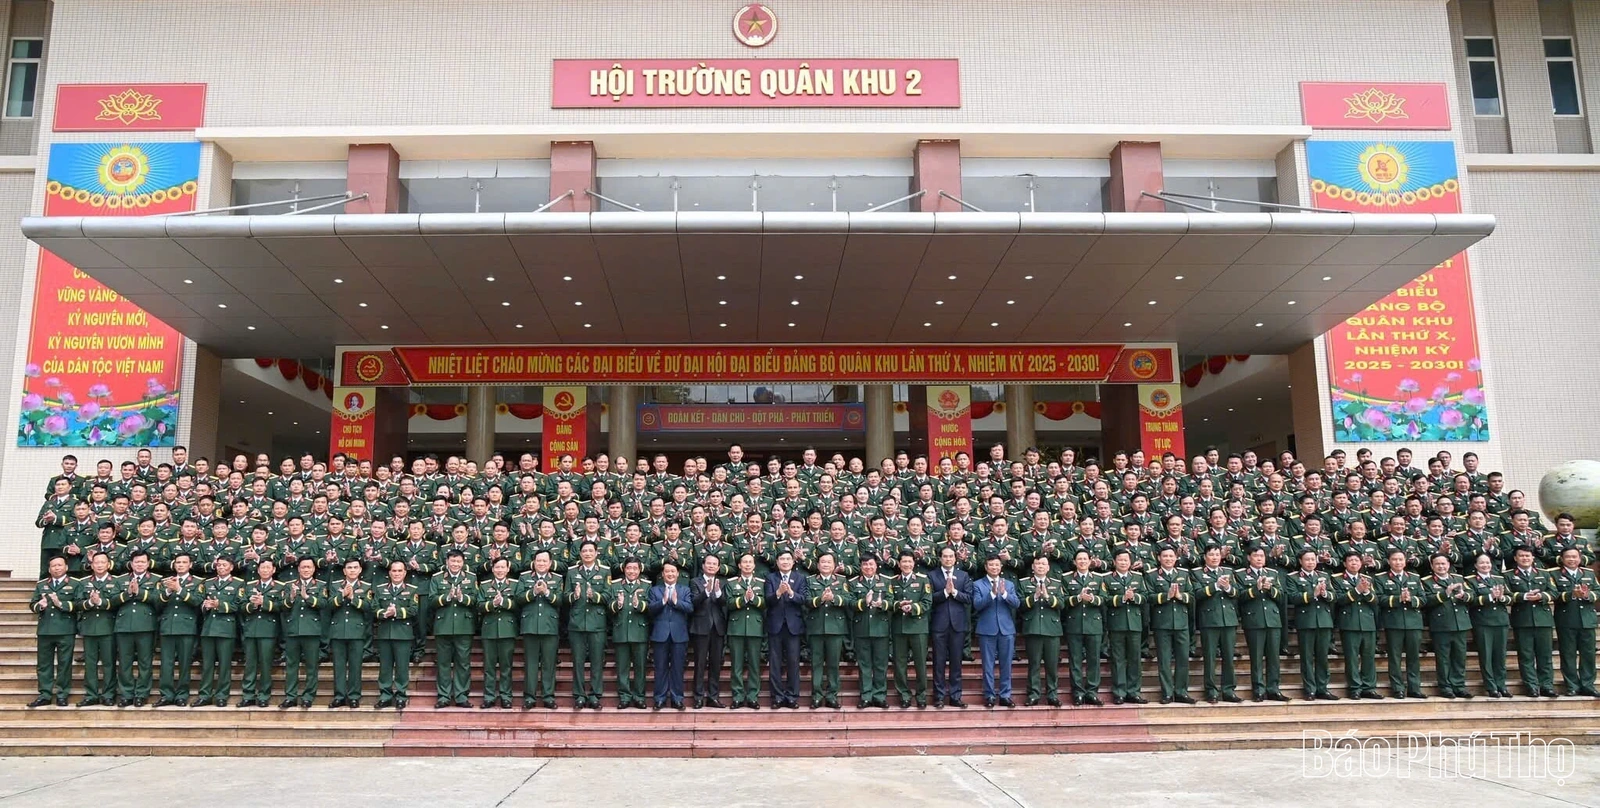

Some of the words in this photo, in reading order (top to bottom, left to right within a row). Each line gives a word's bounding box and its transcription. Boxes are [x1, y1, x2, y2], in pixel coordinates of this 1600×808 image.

[590, 63, 634, 102] HỘI
[642, 62, 751, 96] TRƯỜNG
[760, 62, 834, 98] QUÂN
[842, 68, 896, 96] KHU
[905, 69, 922, 96] 2
[57, 285, 86, 303] VỮNG
[88, 285, 118, 302] VÀNG
[1397, 281, 1438, 297] BIỂU
[1417, 300, 1446, 314] BỘ
[67, 307, 82, 326] KỶ
[83, 309, 124, 326] NGUYÊN
[125, 308, 149, 329] MỚI,
[1345, 315, 1405, 326] QUÂN
[1412, 316, 1453, 326] KHU
[47, 331, 62, 350] KỶ
[63, 332, 104, 350] NGUYÊN
[107, 335, 135, 350] VƯƠN
[137, 332, 164, 350] MÌNH
[1346, 328, 1385, 341] LẦN
[1391, 329, 1430, 341] THỨ
[1435, 331, 1456, 342] X,
[1354, 344, 1418, 357] NHIỆM
[43, 355, 65, 374] CỦA
[67, 356, 89, 374] DÂN
[91, 356, 113, 378] TỘC
[116, 356, 135, 378] VIỆT
[137, 359, 164, 374] NAM!
[428, 352, 463, 378] NHIỆT
[465, 352, 490, 378] LIỆT
[492, 351, 524, 374] CHÀO
[527, 351, 563, 374] MỪNG
[566, 351, 590, 374] CÁC
[592, 355, 613, 377] ĐẠI
[616, 348, 644, 374] BIỂU
[646, 349, 661, 374] VỀ
[664, 354, 682, 377] DỰ
[683, 355, 703, 377] ĐẠI
[707, 351, 727, 377] HỘI
[730, 355, 750, 377] ĐẠI
[753, 347, 781, 373] BIỂU
[783, 349, 817, 373] ĐẢNG
[819, 351, 836, 376] BỘ
[839, 351, 872, 375] QUÂN
[874, 354, 899, 373] KHU
[901, 348, 925, 373] LẦN
[927, 351, 952, 373] THỨ
[953, 354, 966, 375] X,
[967, 351, 1007, 376] NHIỆM
[1009, 351, 1025, 373] KỲ
[1028, 354, 1057, 372] 2025
[1067, 354, 1100, 372] 2030!
[1344, 360, 1392, 370] 2025
[1410, 360, 1464, 370] 2030!
